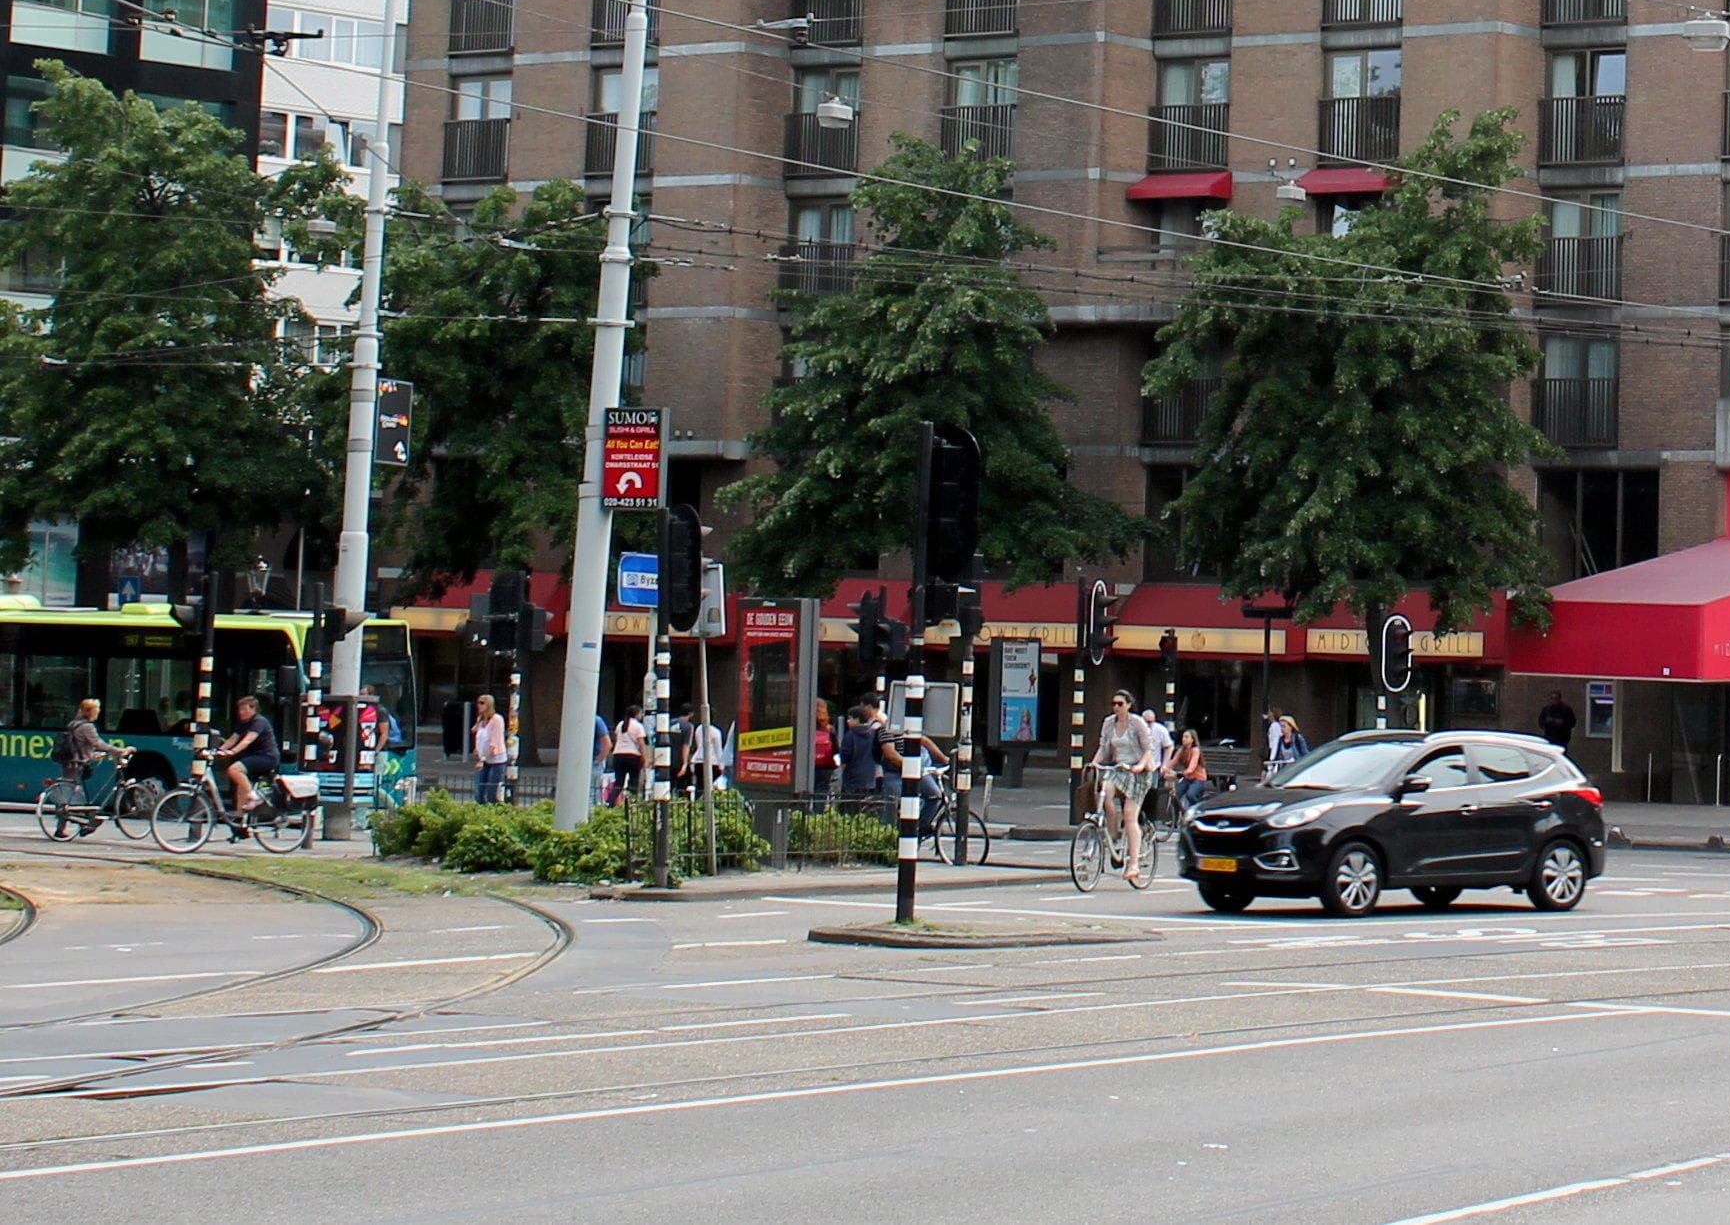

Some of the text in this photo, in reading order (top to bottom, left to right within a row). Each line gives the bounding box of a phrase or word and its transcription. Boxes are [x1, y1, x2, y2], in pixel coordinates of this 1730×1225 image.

[608, 411, 647, 425] SUMO
[605, 440, 615, 449] All
[617, 440, 628, 449] You
[629, 440, 643, 449] Can
